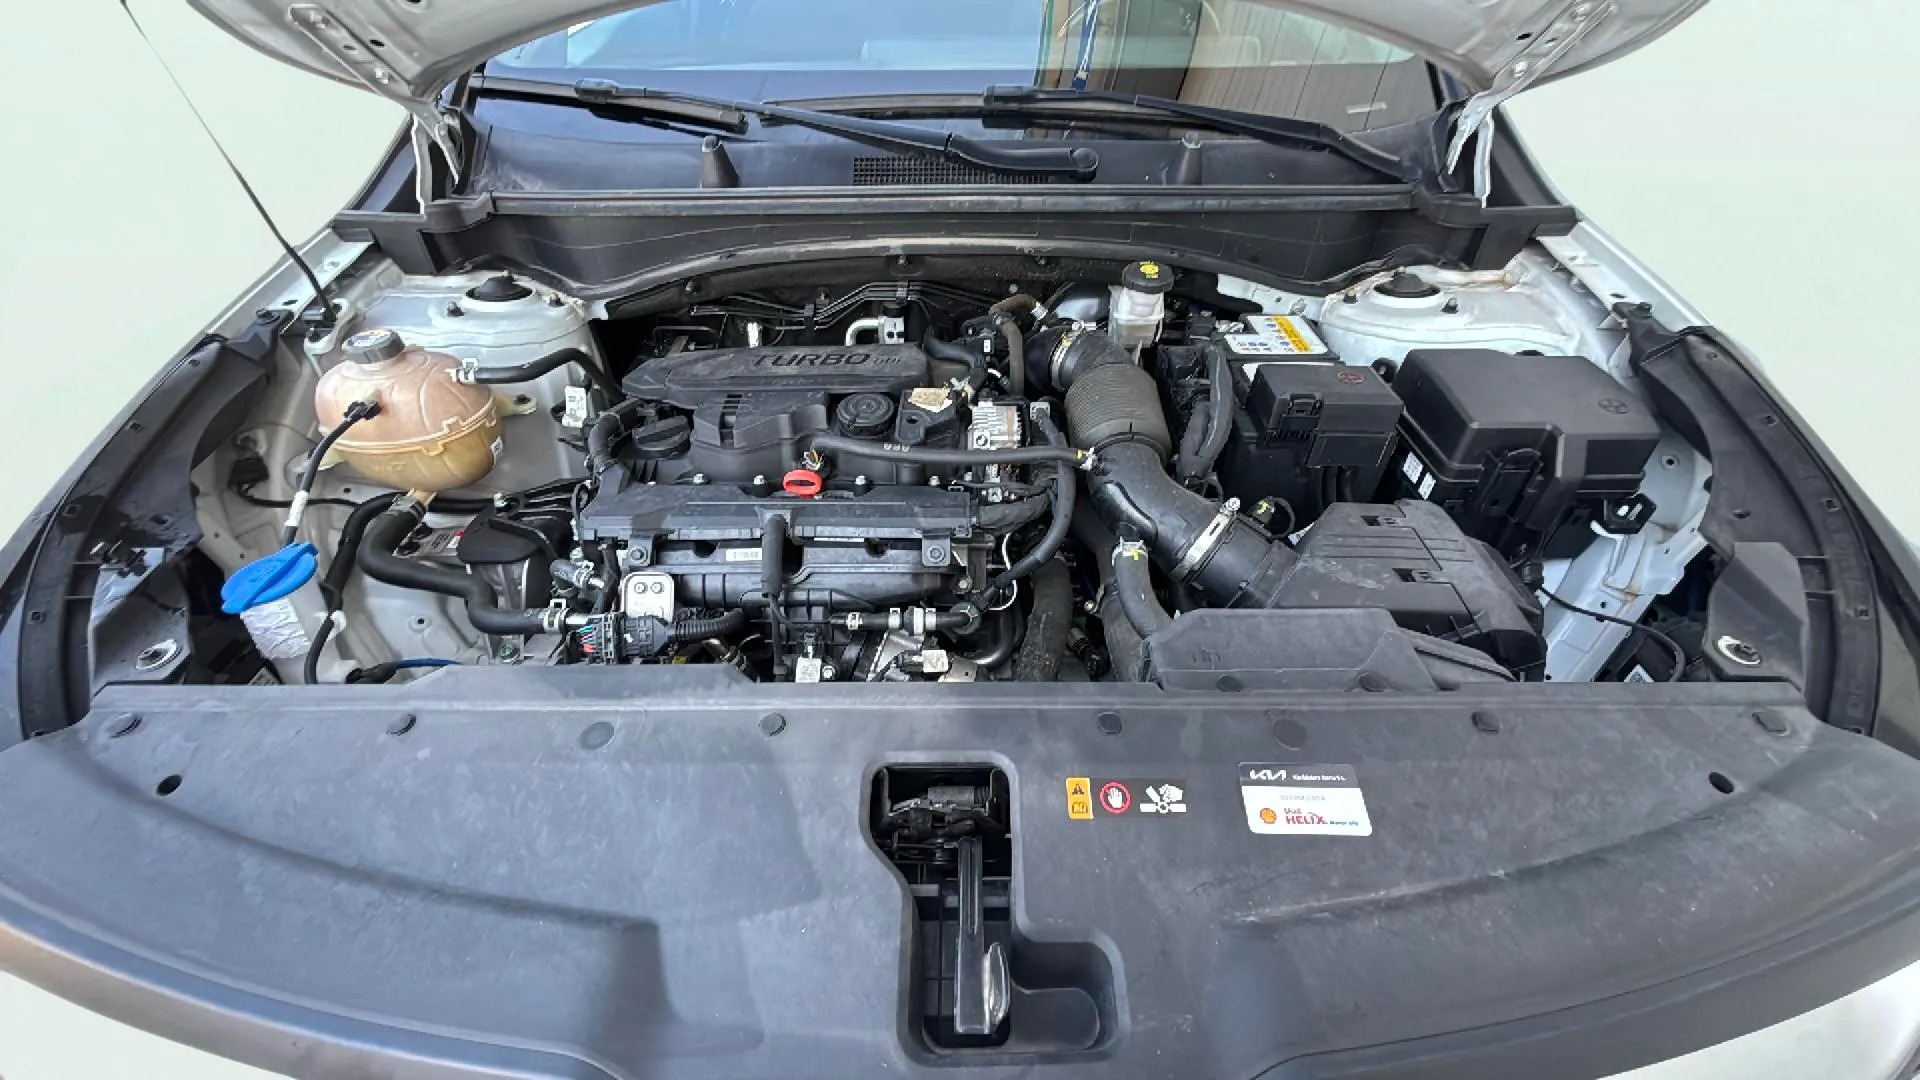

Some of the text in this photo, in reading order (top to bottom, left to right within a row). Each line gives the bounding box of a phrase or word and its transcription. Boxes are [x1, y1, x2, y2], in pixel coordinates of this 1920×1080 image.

[754, 353, 871, 367] TURBO
[1249, 769, 1287, 781] KIA
[1285, 815, 1327, 825] HELIX
